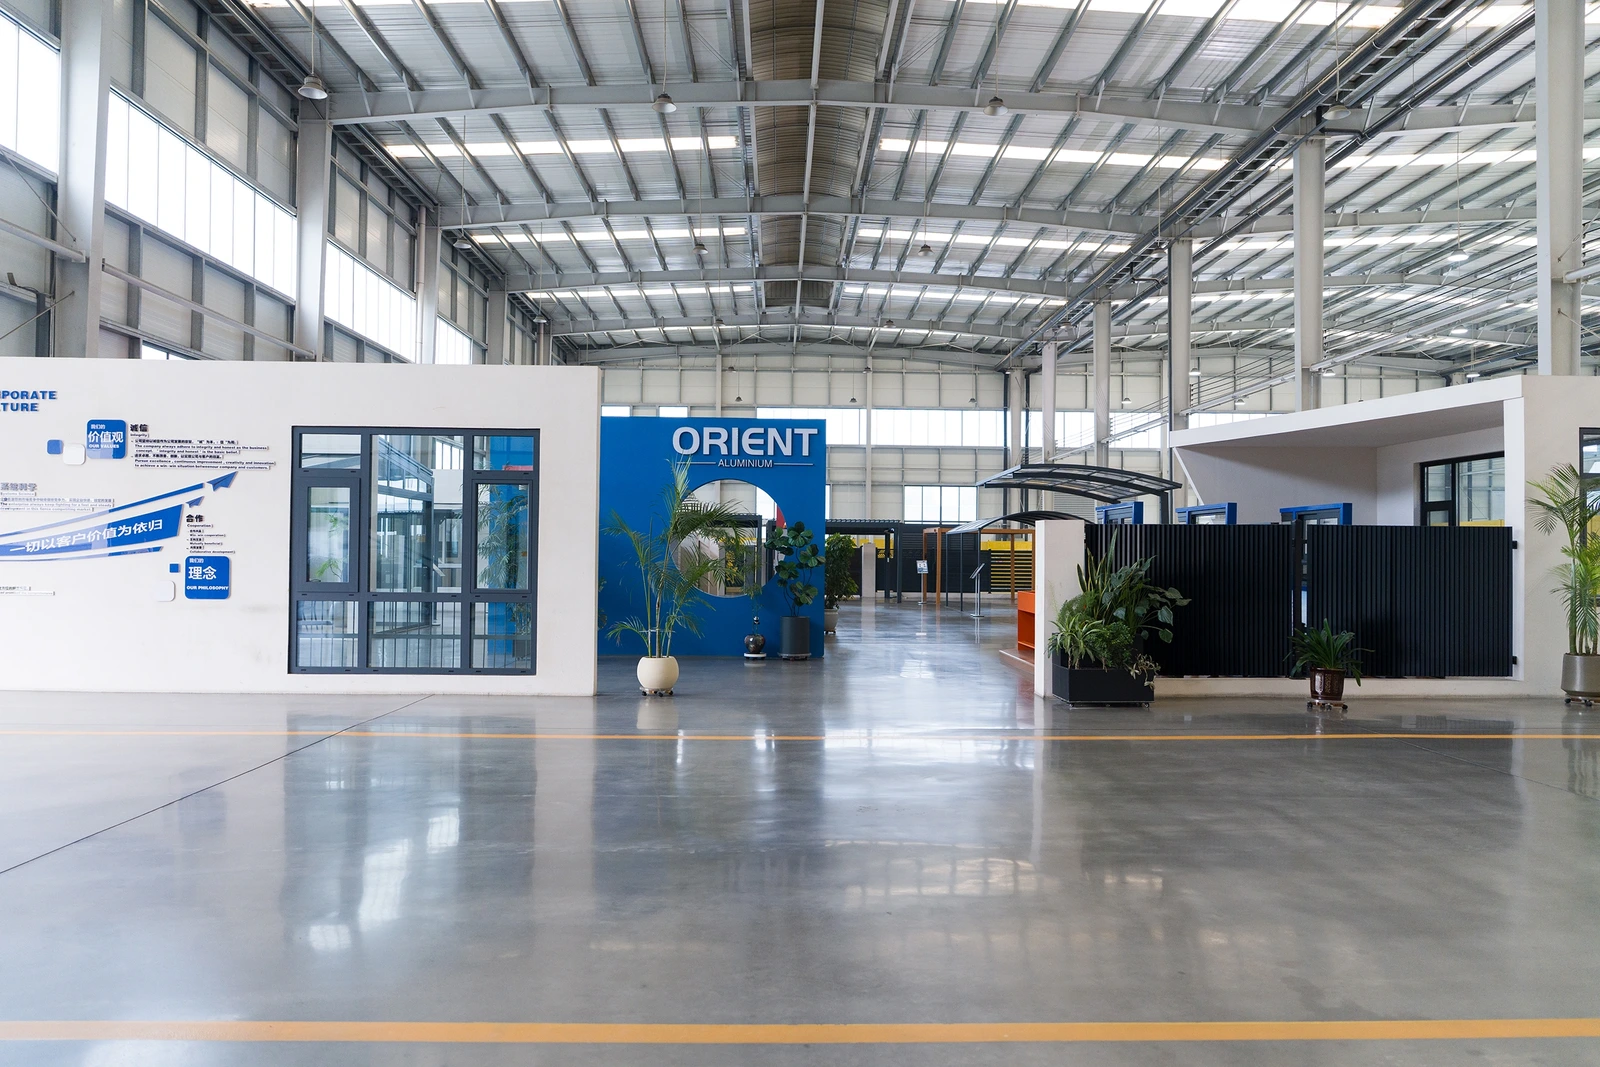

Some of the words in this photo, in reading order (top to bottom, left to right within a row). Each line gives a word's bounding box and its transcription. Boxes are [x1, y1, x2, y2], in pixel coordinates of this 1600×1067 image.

[0, 390, 57, 400] PORATE
[0, 402, 39, 412] TURE
[130, 423, 148, 432] 诚信
[88, 430, 124, 443] 价值观
[672, 426, 818, 456] ORIENT
[718, 458, 773, 468] ALUMINIUM
[186, 514, 204, 522] 合作
[9, 519, 163, 553] 一切以客户价值为依归
[188, 565, 217, 580] 理念
